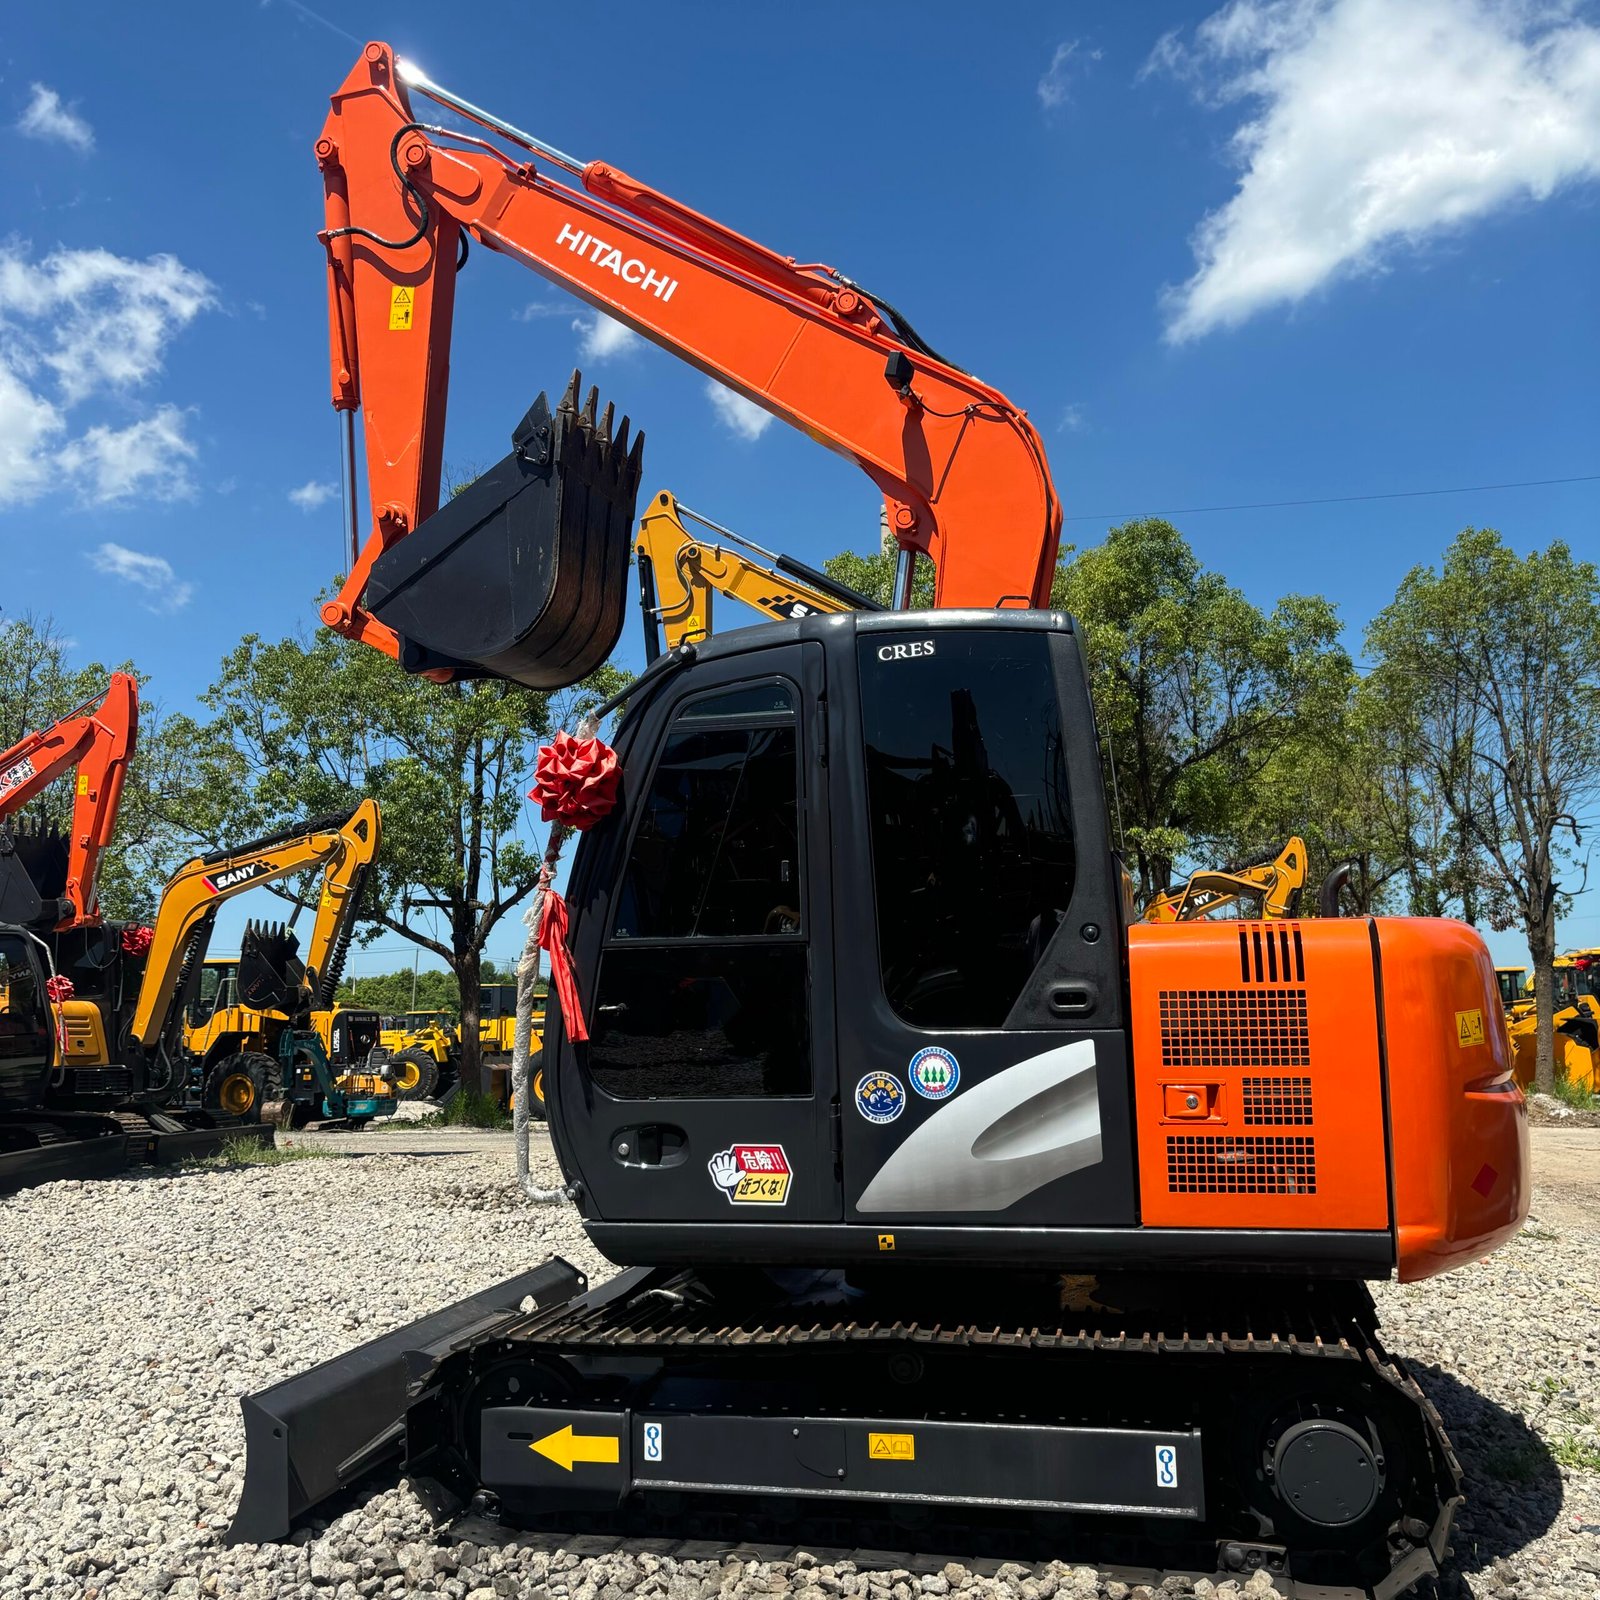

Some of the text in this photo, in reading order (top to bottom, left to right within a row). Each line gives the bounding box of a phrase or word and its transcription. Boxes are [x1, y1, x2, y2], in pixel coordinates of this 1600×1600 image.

[555, 223, 679, 303] HITACHI
[789, 603, 818, 618] S
[878, 640, 935, 661] CRES
[216, 864, 256, 889] SANY
